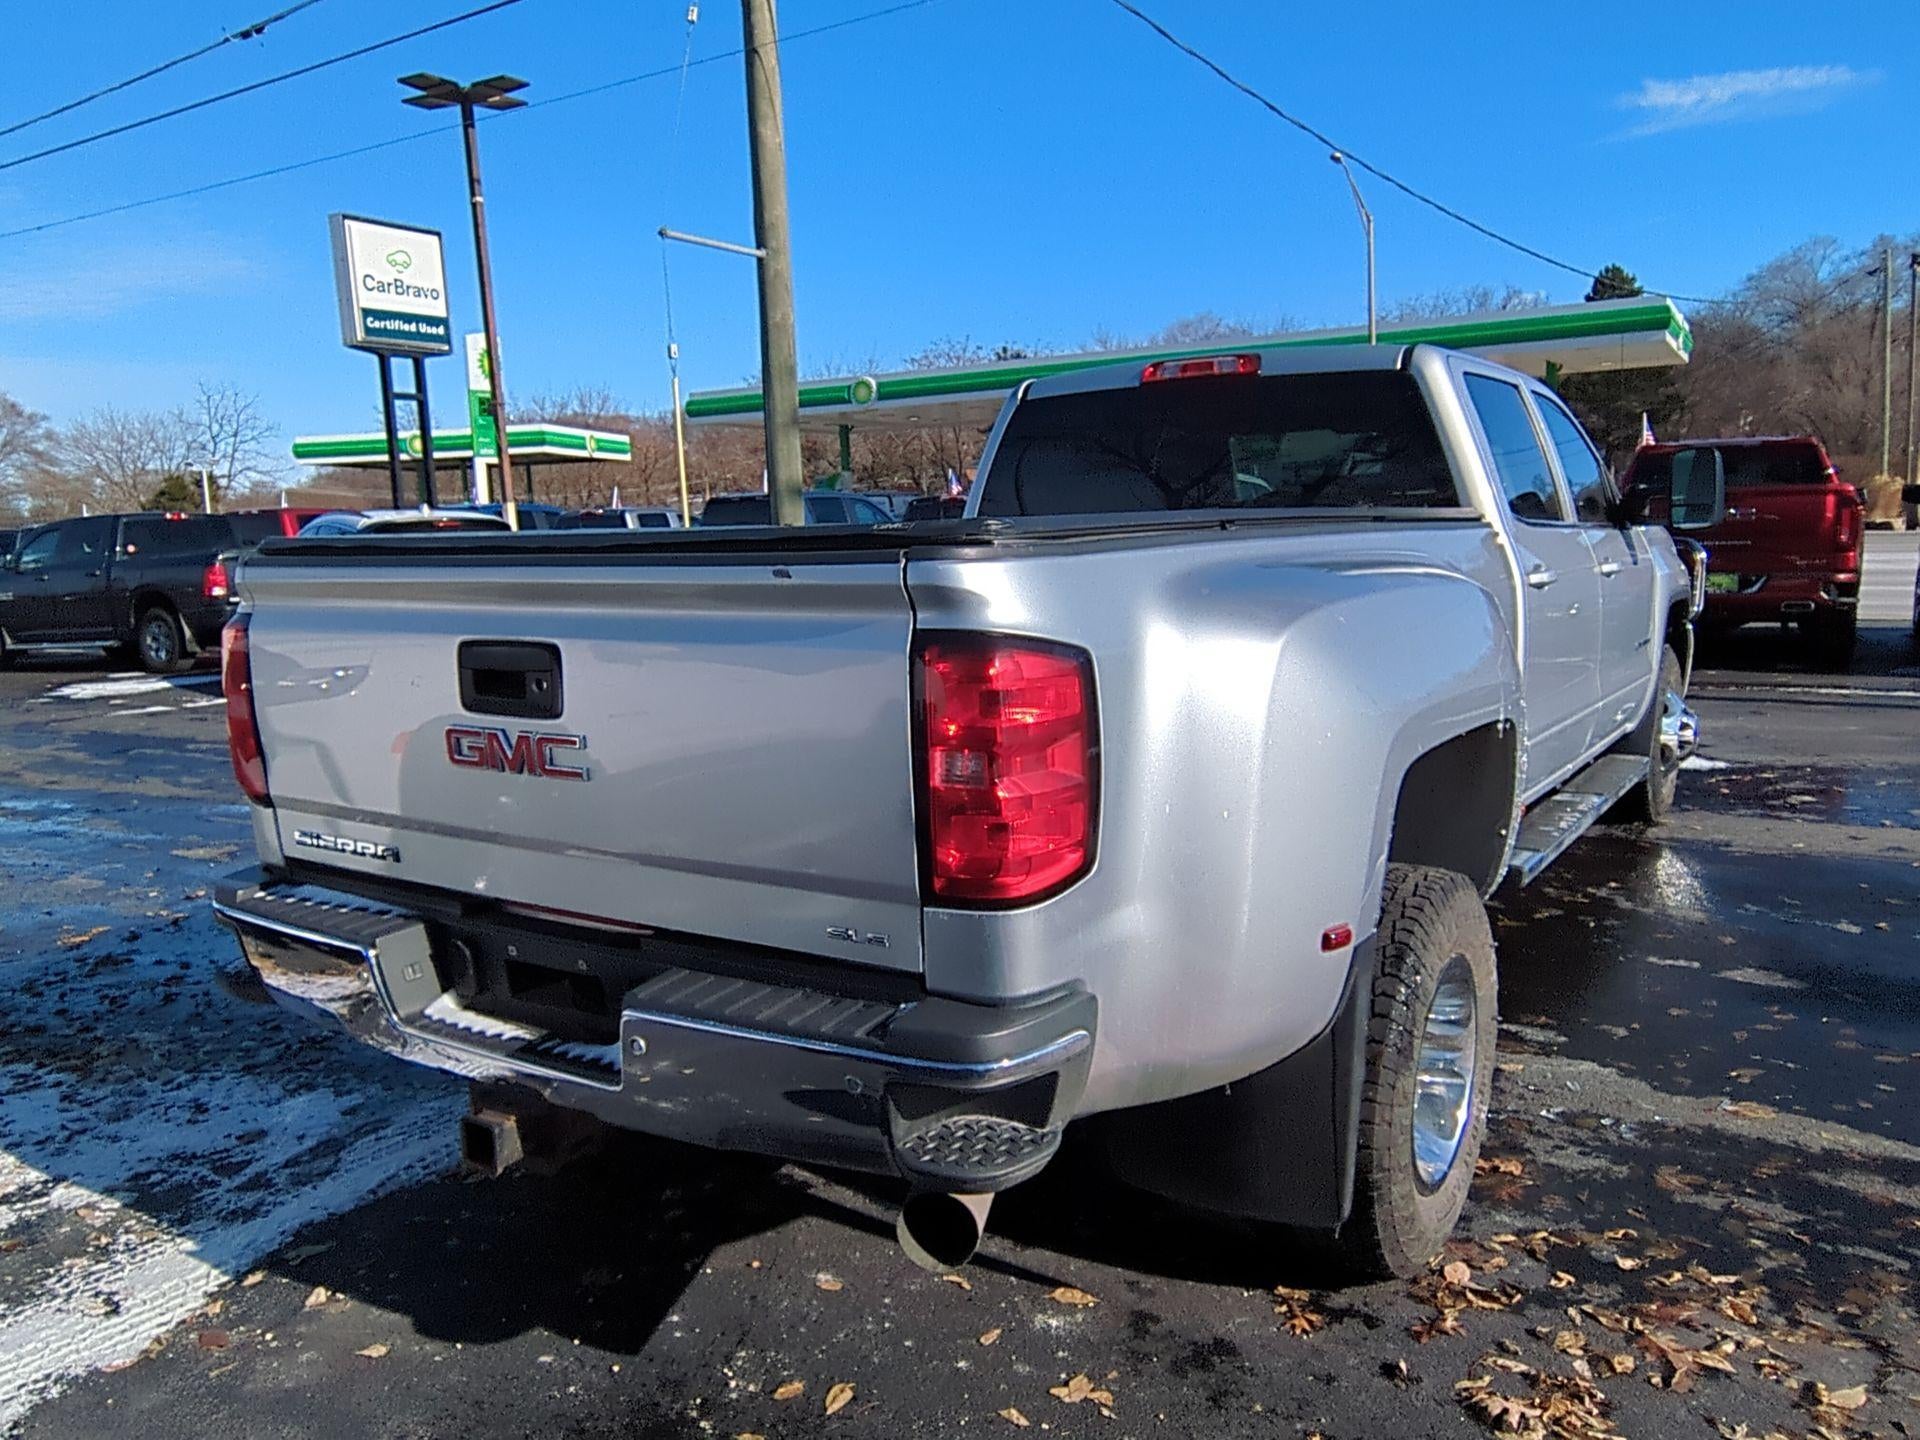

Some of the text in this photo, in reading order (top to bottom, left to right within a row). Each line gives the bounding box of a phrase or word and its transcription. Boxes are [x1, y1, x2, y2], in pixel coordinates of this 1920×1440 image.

[362, 274, 440, 300] CarBravo
[366, 316, 445, 335] Certified Used
[445, 724, 591, 782] GMC
[293, 829, 402, 863] SIERRA
